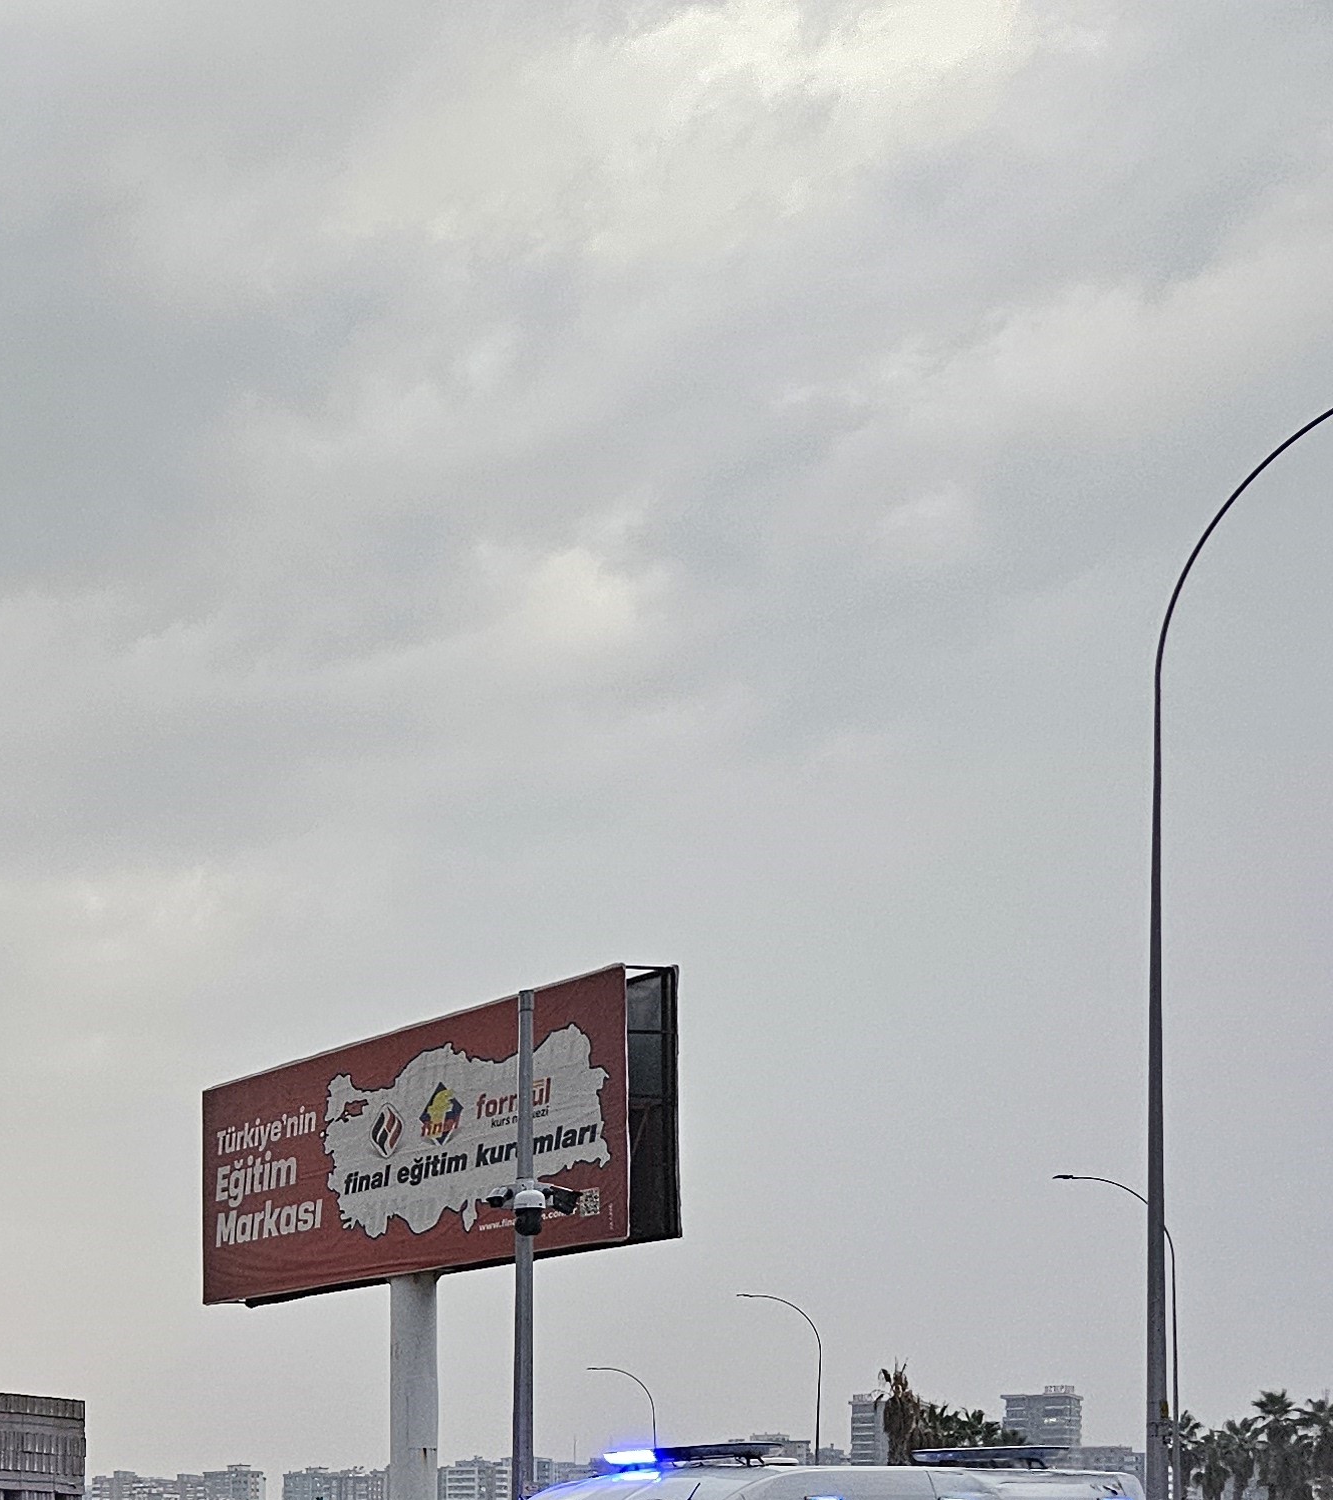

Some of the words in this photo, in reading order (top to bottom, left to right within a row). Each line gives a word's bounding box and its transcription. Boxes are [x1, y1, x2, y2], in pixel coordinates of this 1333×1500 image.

[217, 1105, 317, 1156] Türkiye'nin
[490, 1115, 510, 1128] kurs
[215, 1150, 297, 1208] Eğitim
[344, 1164, 391, 1195] final
[397, 1152, 468, 1186] eğitim
[475, 1123, 598, 1168] kurmları
[215, 1199, 323, 1248] Markası
